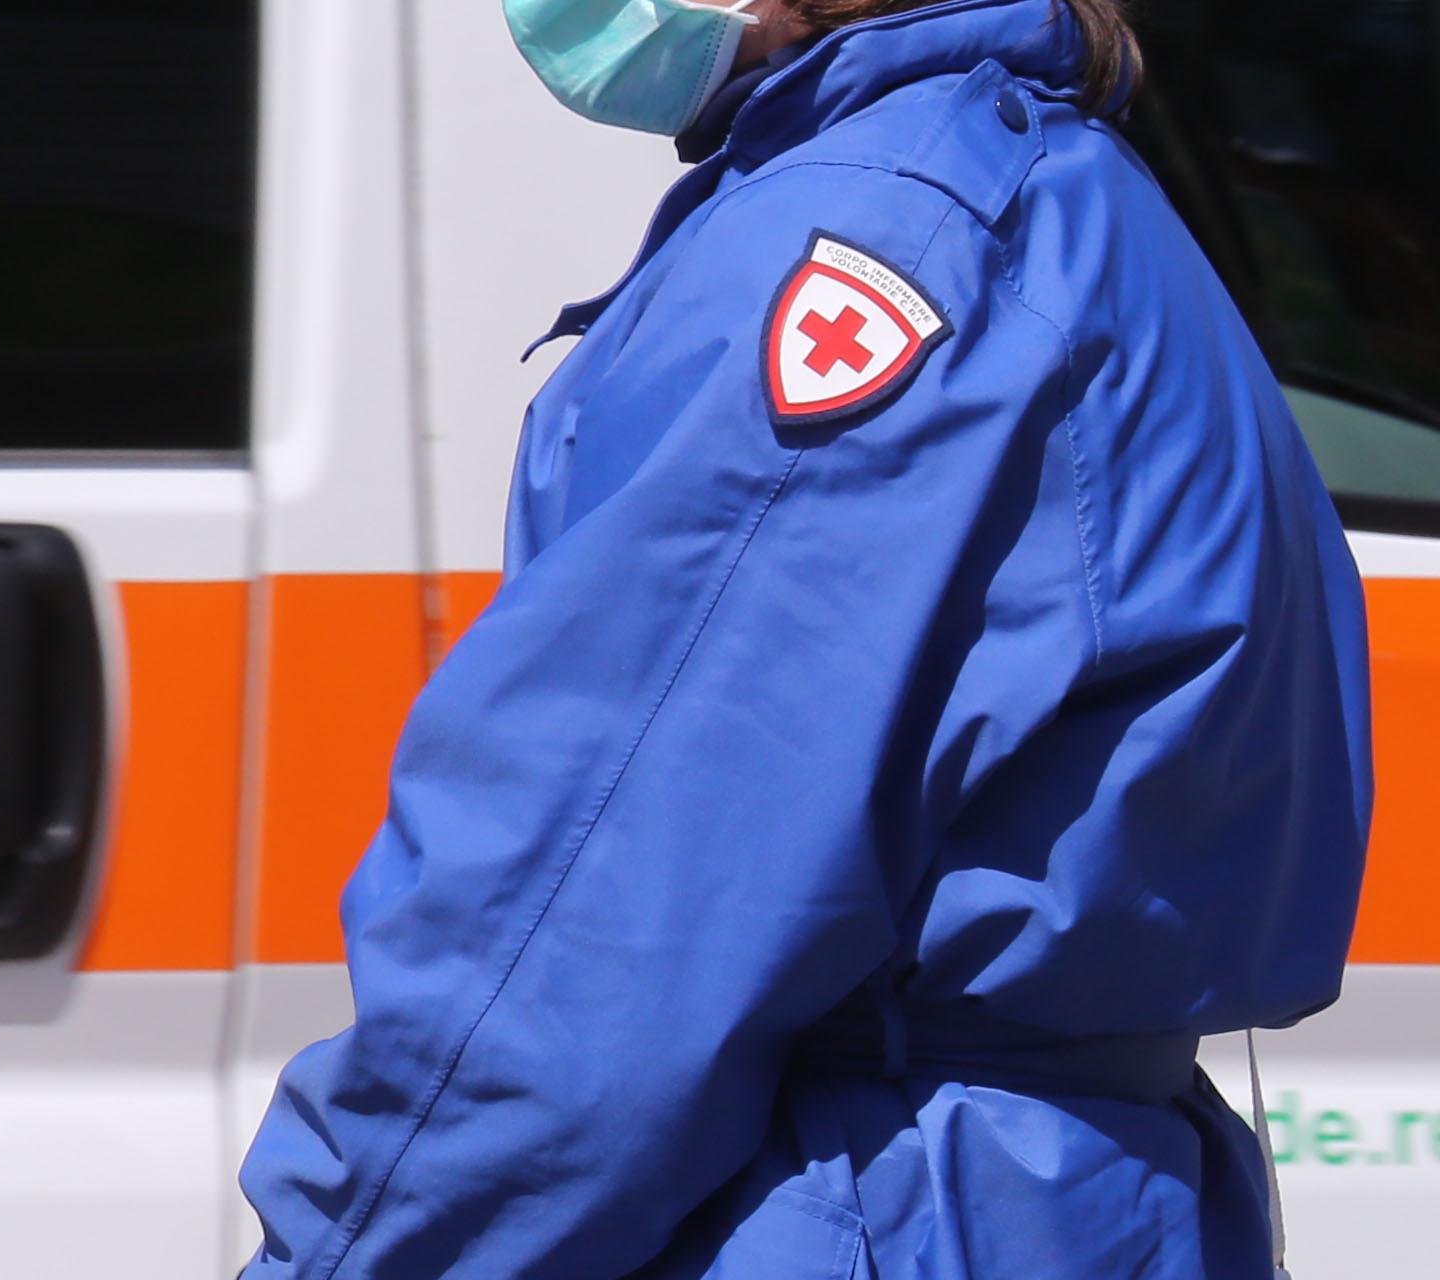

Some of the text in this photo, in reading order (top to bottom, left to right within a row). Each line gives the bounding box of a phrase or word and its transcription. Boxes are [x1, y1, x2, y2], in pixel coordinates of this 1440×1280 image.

[826, 245, 933, 324] CORPO INFERMIERE
[830, 256, 897, 297] VOLONTARIE
